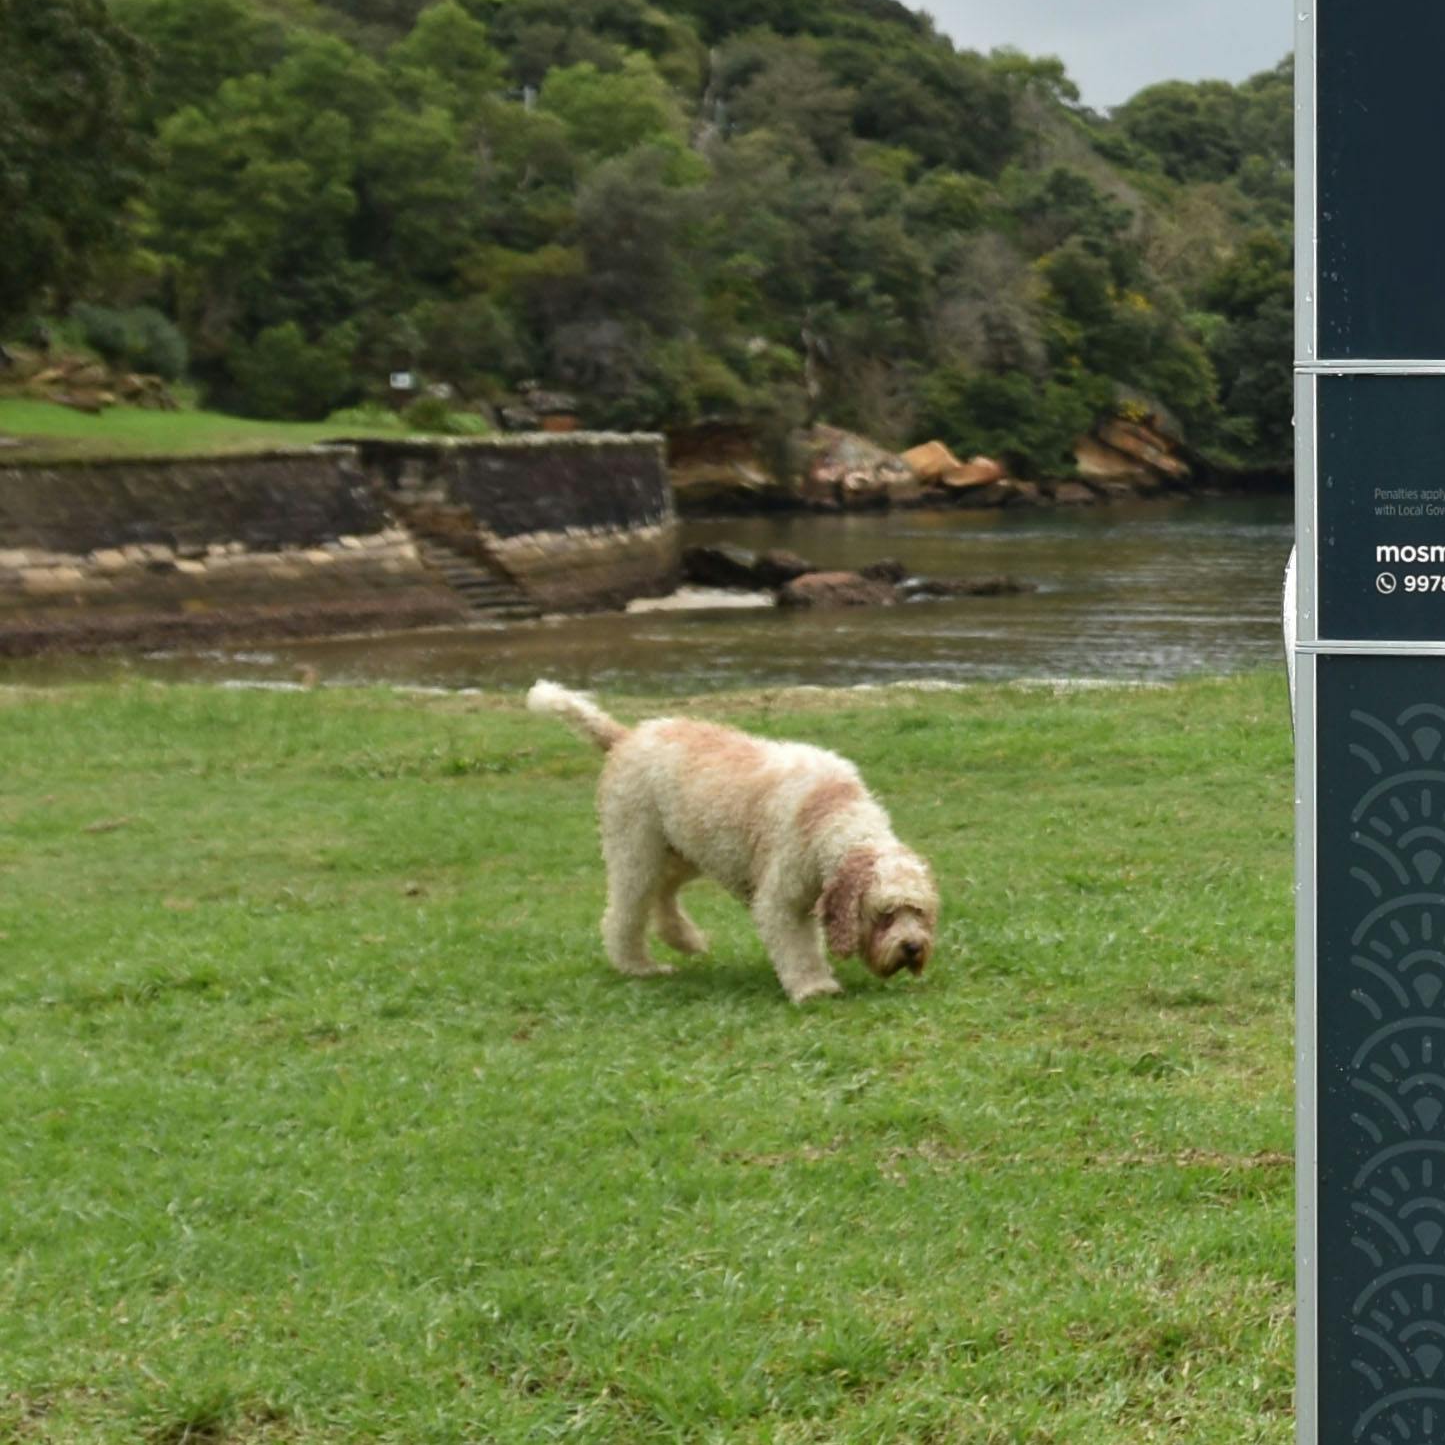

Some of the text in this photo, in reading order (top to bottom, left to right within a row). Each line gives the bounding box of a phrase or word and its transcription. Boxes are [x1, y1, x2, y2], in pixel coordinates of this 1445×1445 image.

[1374, 488, 1418, 499] Penalties
[1374, 504, 1396, 515] with
[1398, 504, 1423, 515] Local
